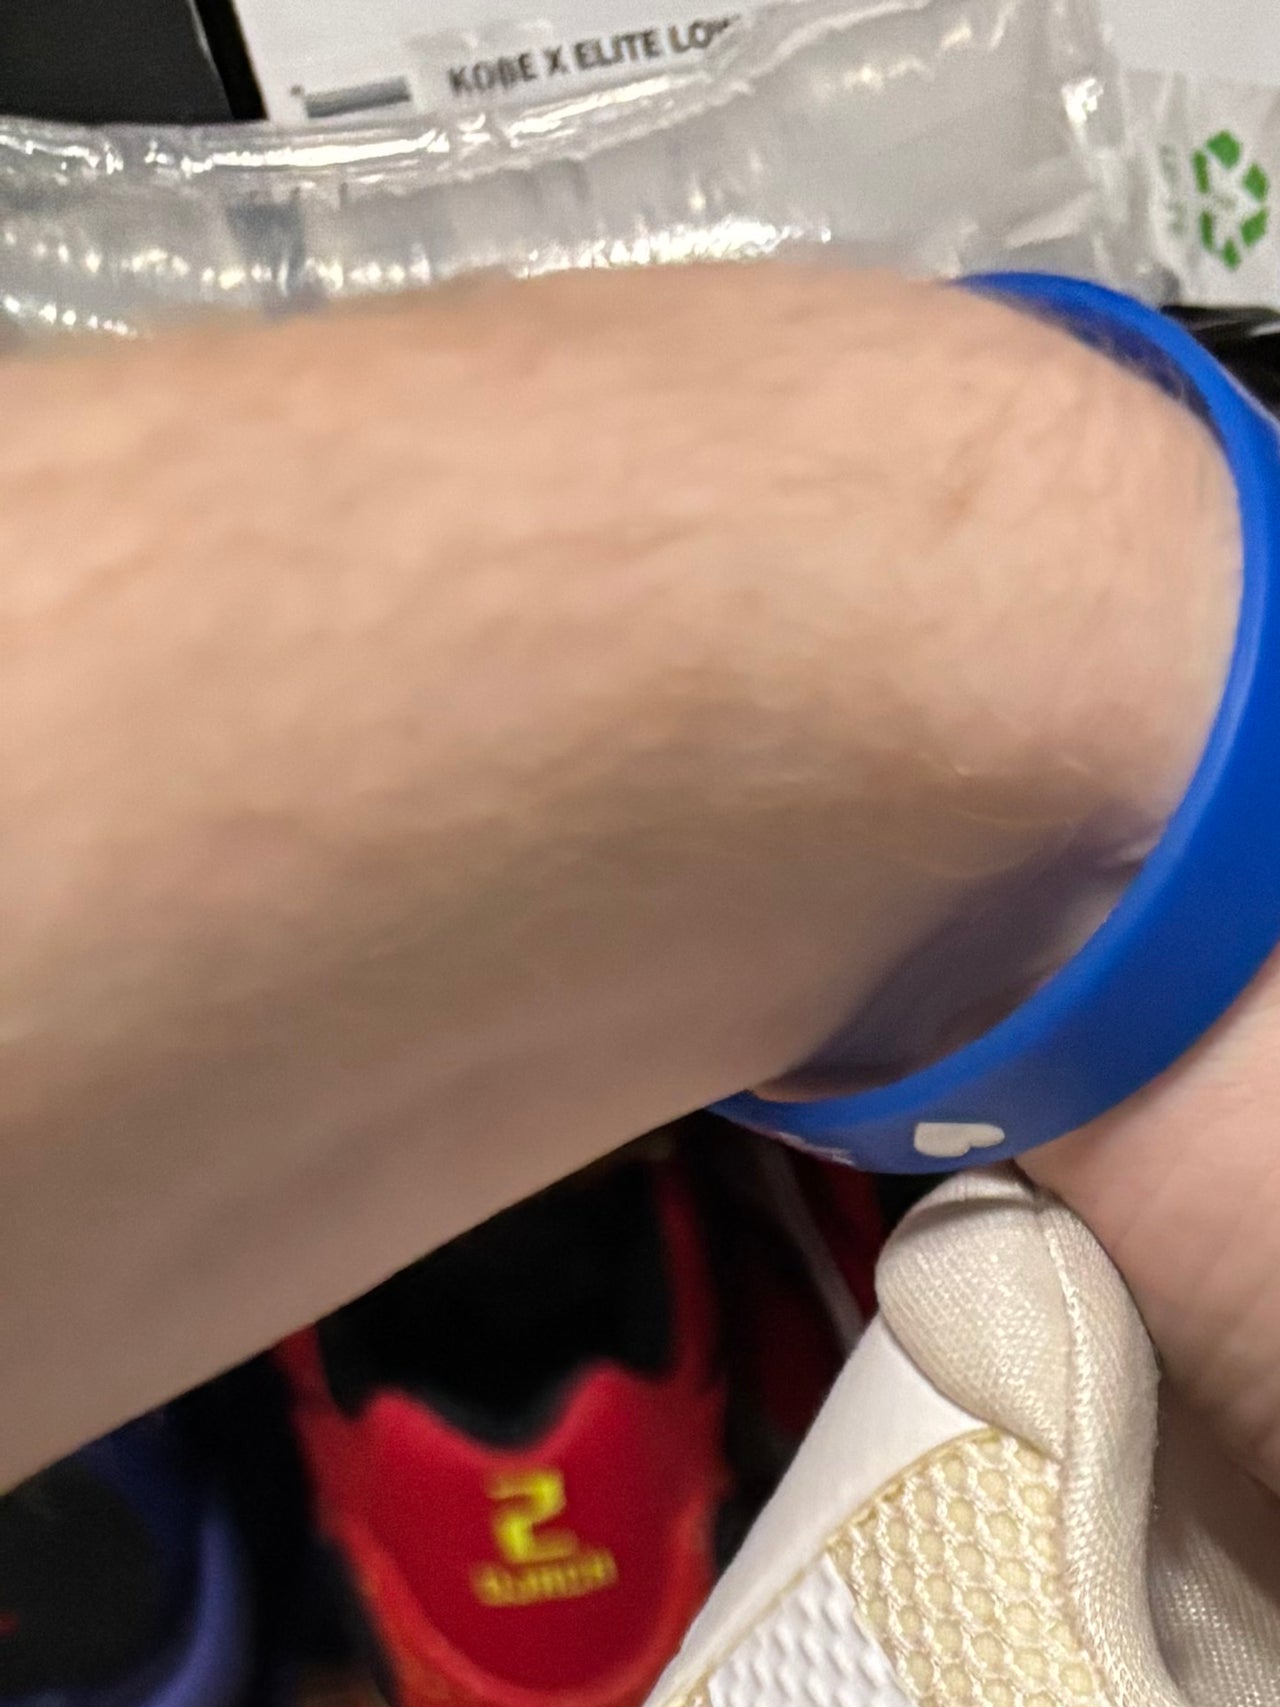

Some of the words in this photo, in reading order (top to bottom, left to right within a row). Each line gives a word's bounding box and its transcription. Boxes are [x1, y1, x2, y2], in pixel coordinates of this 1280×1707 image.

[447, 52, 537, 97] KOBE
[544, 46, 571, 75] X
[573, 27, 665, 70] ELITE
